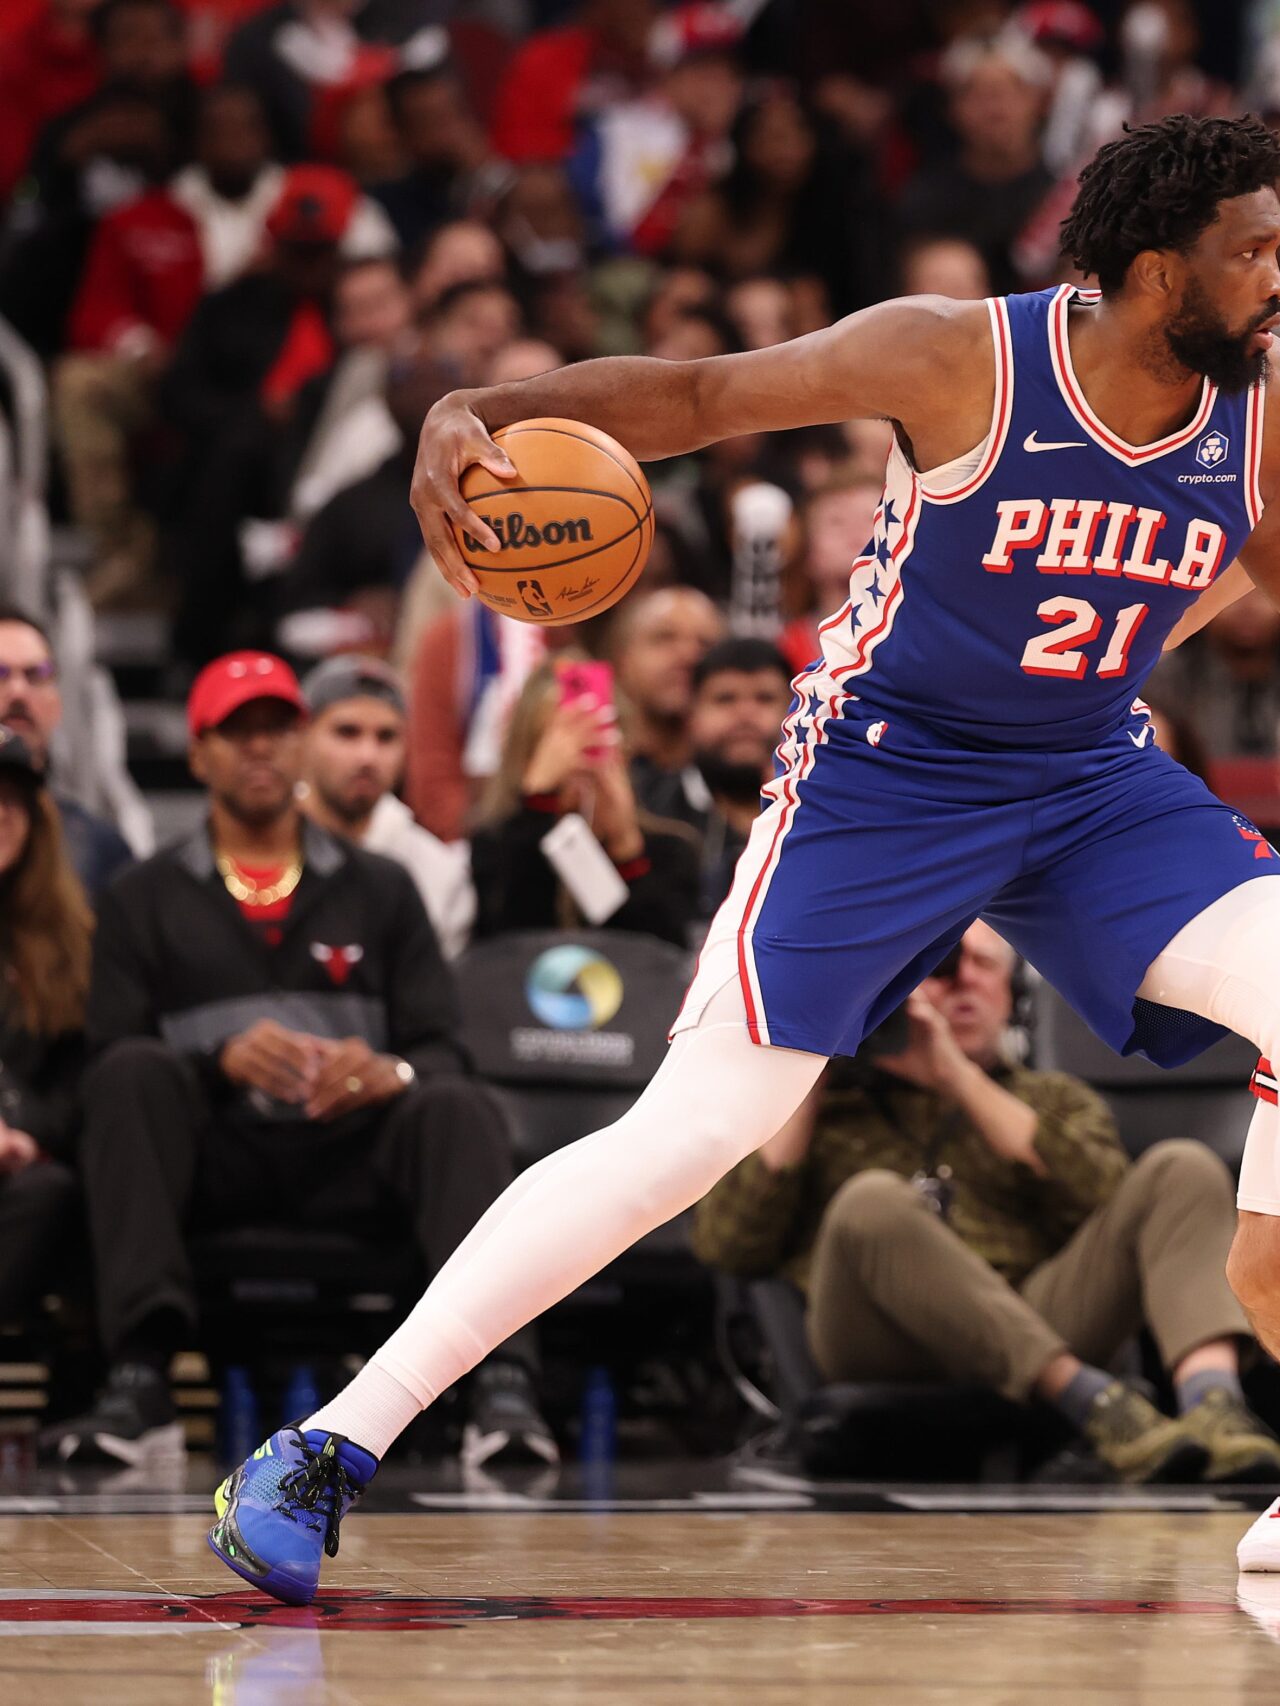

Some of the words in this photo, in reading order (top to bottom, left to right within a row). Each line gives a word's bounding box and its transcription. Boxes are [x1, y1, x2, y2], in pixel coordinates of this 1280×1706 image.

[1177, 473, 1237, 485] crypto.com
[981, 498, 1227, 591] PHILA
[1020, 595, 1149, 680] 21
